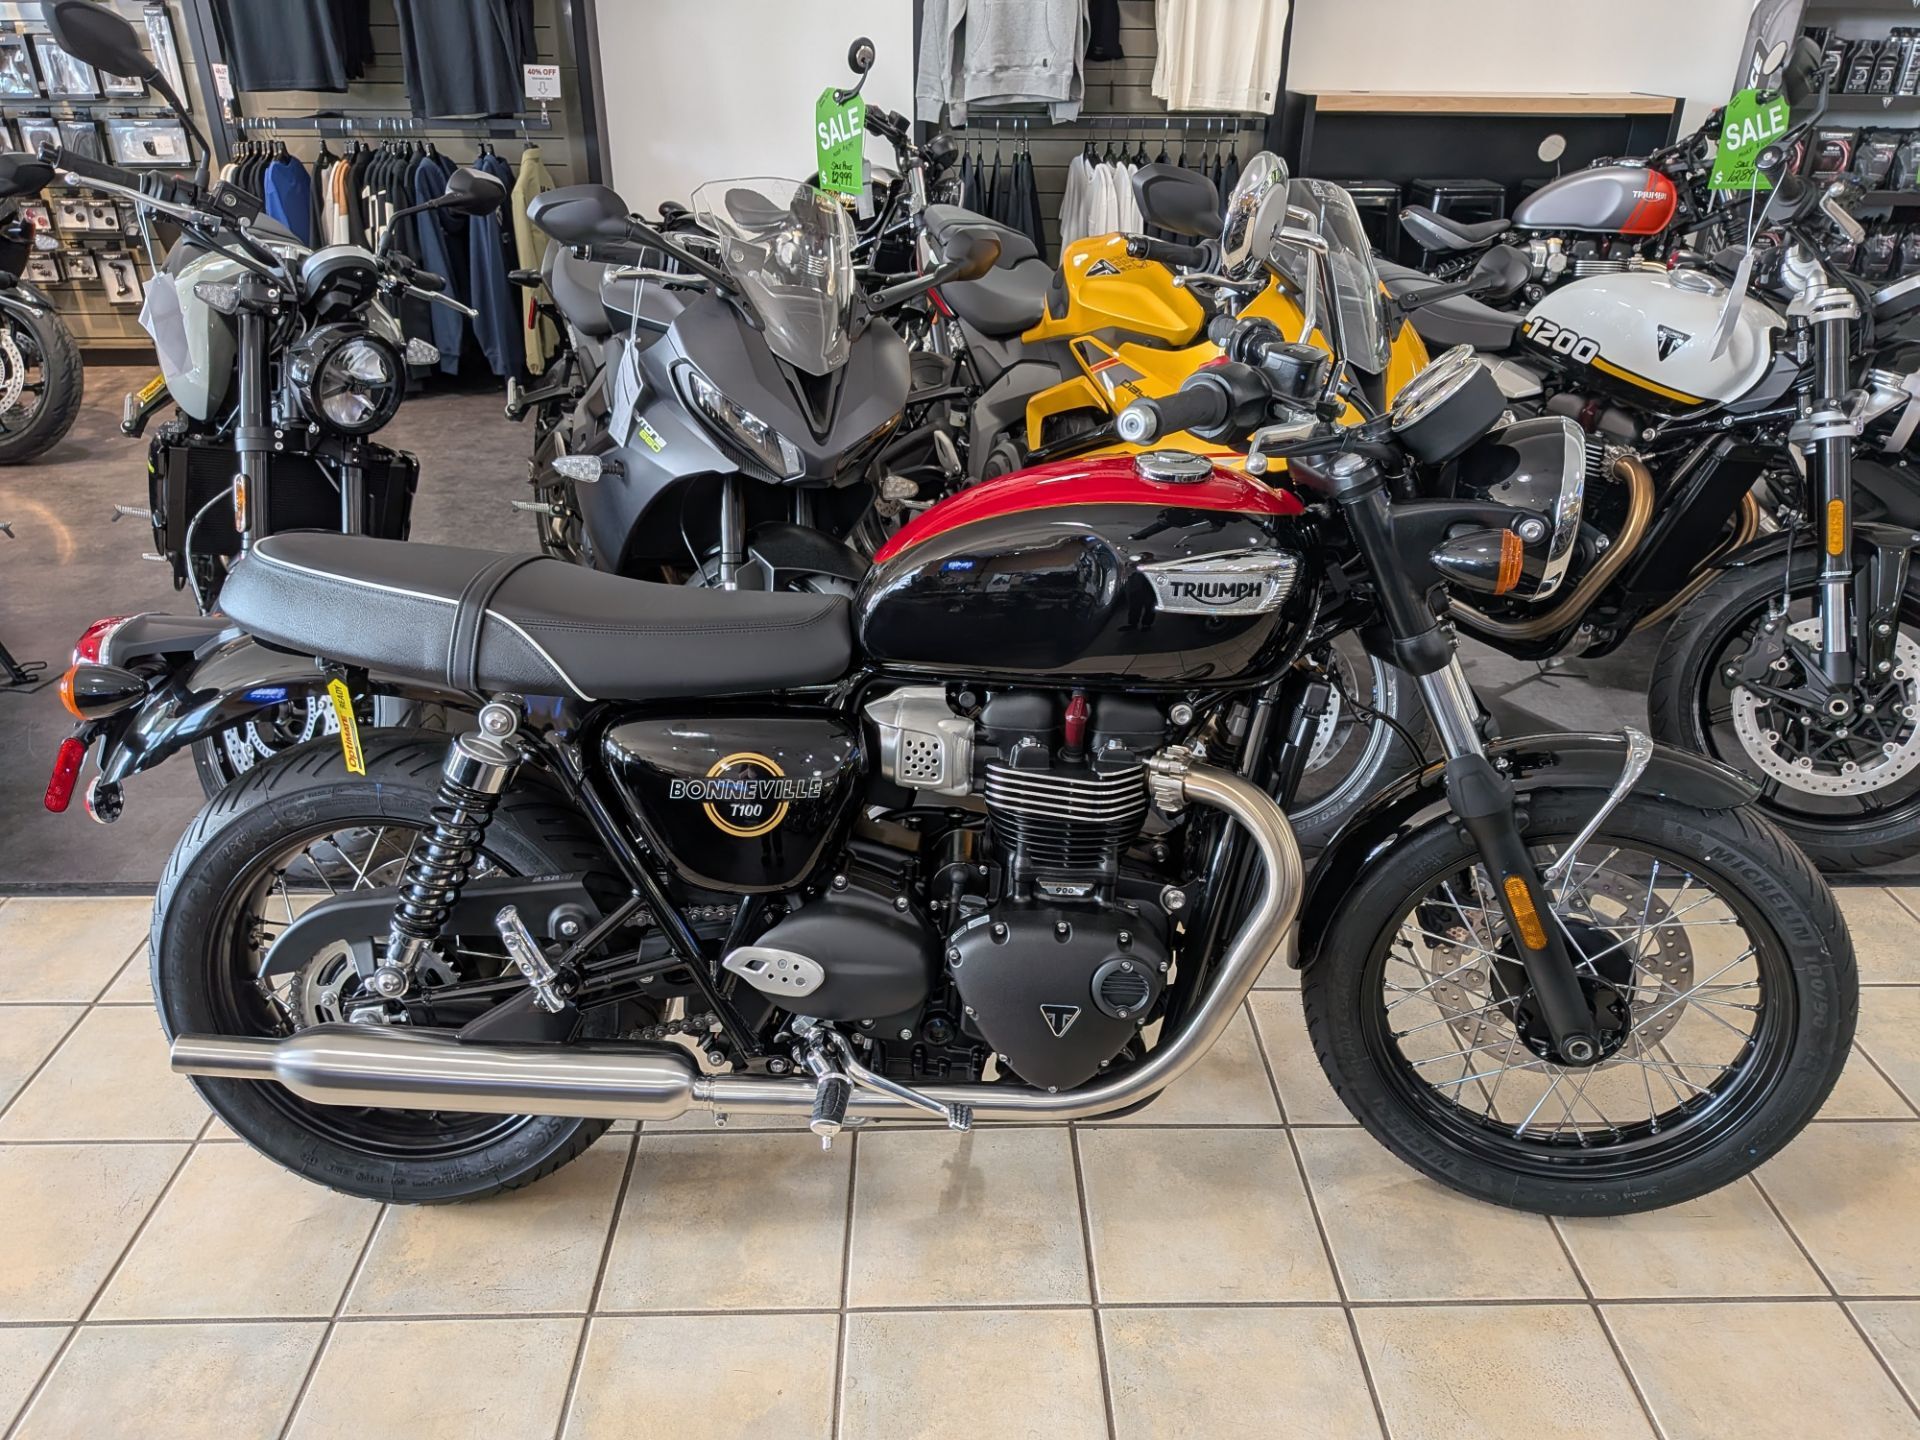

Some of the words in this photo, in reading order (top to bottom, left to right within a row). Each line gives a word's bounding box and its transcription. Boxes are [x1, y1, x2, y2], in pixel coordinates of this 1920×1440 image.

[818, 106, 861, 151] SALE
[1726, 105, 1785, 151] SALE
[1524, 315, 1601, 365] 1200
[1170, 581, 1263, 606] TRIUMPH
[669, 779, 823, 800] BONNEVILLE
[730, 803, 763, 817] T100
[1707, 845, 1813, 942] MICHELIN
